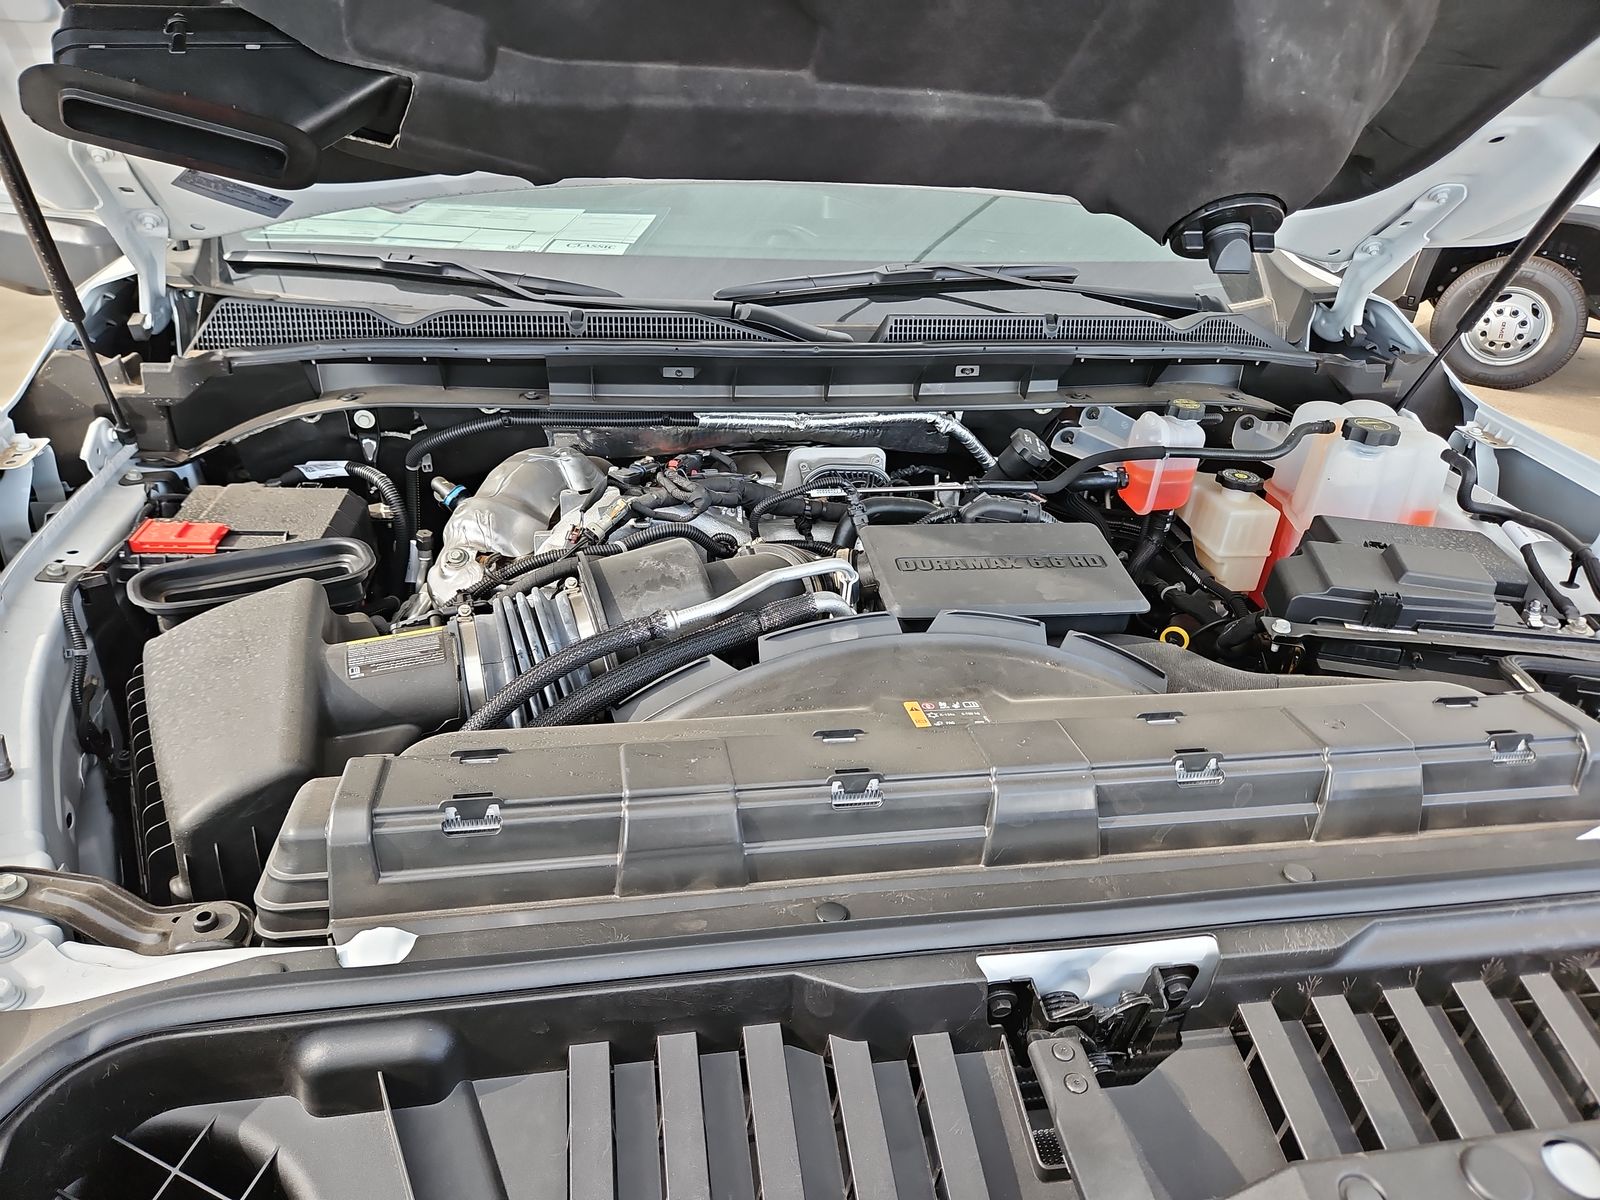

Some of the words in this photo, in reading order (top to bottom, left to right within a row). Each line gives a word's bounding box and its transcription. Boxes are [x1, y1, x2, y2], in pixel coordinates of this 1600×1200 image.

[566, 242, 617, 250] CLASSIC
[1498, 321, 1507, 339] GMC
[897, 557, 1022, 572] DURAMAX
[1026, 556, 1066, 569] 6.6
[1067, 555, 1104, 568] HD
